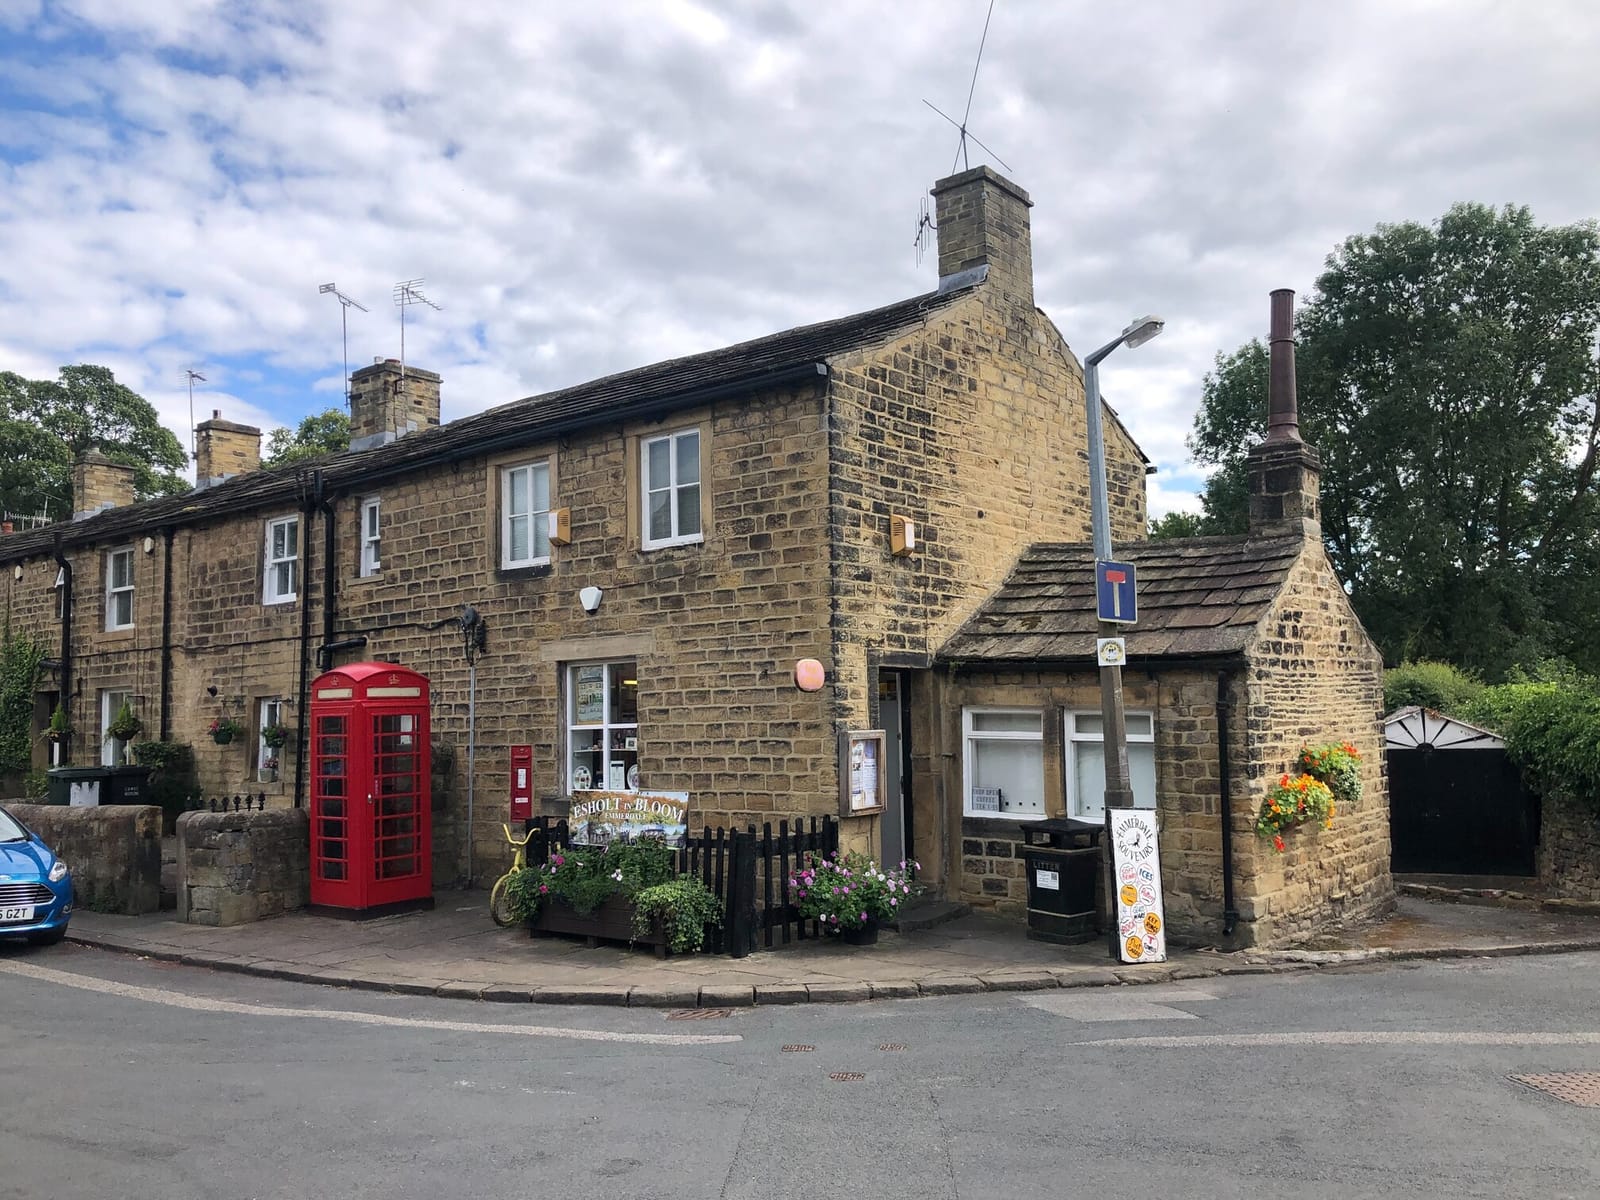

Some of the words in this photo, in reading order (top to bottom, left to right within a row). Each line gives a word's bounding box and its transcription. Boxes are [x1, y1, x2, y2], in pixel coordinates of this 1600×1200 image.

[573, 798, 622, 819] ESHOLT
[635, 798, 683, 823] BLOOM
[604, 812, 647, 820] EMMERDALE
[1116, 817, 1153, 838] EMMERDALE
[1118, 841, 1154, 862] SOUVENIRS
[1139, 868, 1153, 881] ICES
[6, 908, 28, 919] GZT
